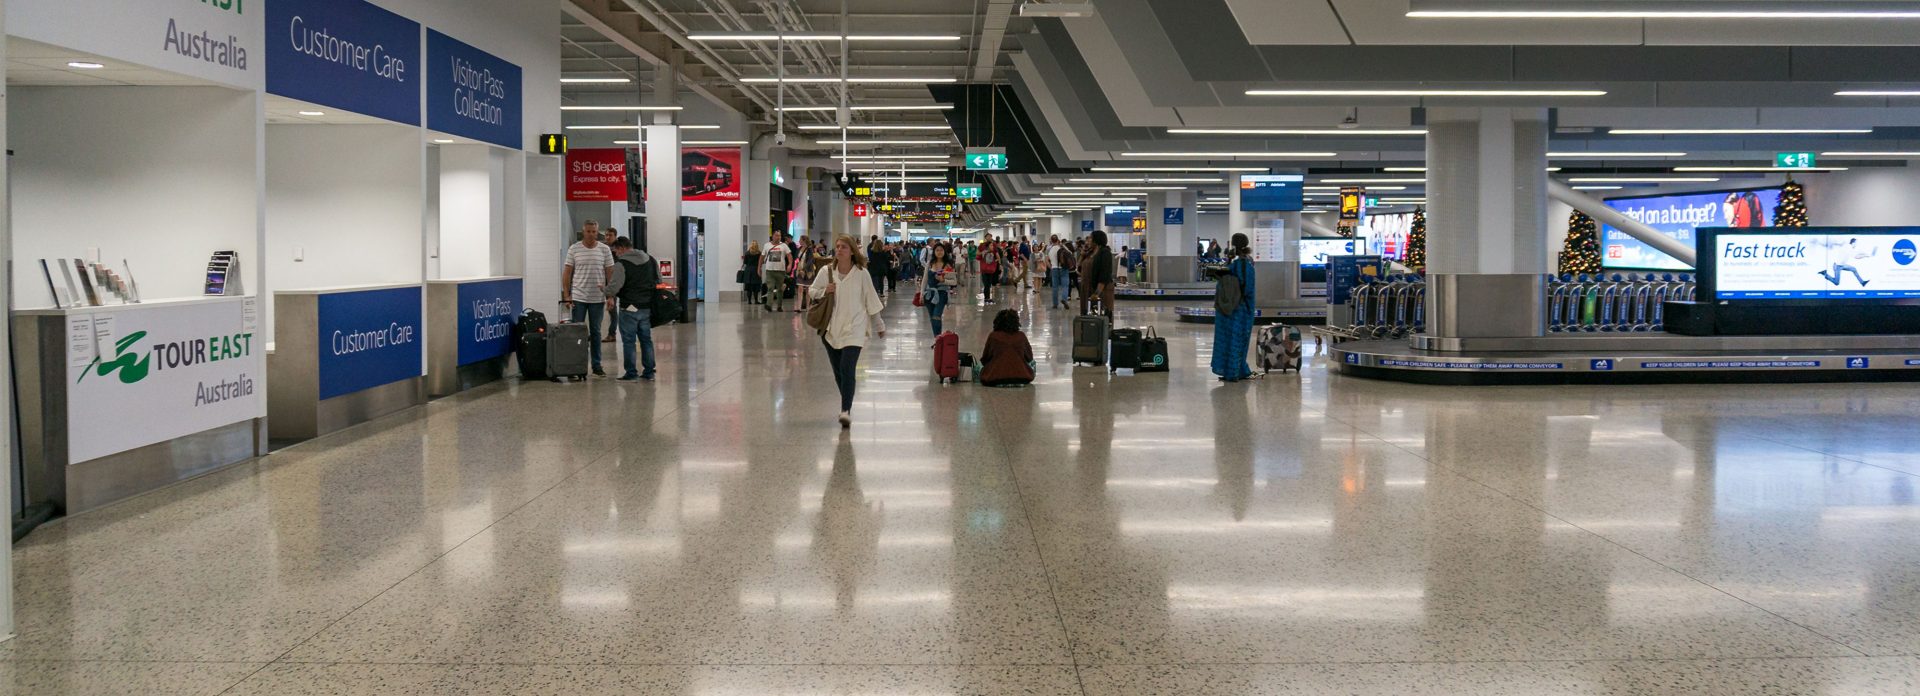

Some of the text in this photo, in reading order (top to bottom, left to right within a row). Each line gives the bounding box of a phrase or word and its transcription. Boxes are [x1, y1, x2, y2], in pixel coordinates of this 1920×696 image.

[164, 18, 246, 70] Australia
[290, 16, 404, 82] Customer Care
[452, 56, 504, 99] Visitor Pass
[454, 88, 502, 126] Collection
[573, 160, 592, 172] $19
[1646, 210, 1660, 224] on
[1661, 209, 1669, 224] a
[1670, 202, 1717, 228] budget?
[1724, 242, 1806, 258] Fast track
[472, 298, 511, 320] Visitor Pass
[332, 322, 412, 355] Customer Care
[474, 319, 510, 342] Collection
[154, 333, 252, 370] TOUR EAST
[195, 373, 252, 407] Australia
